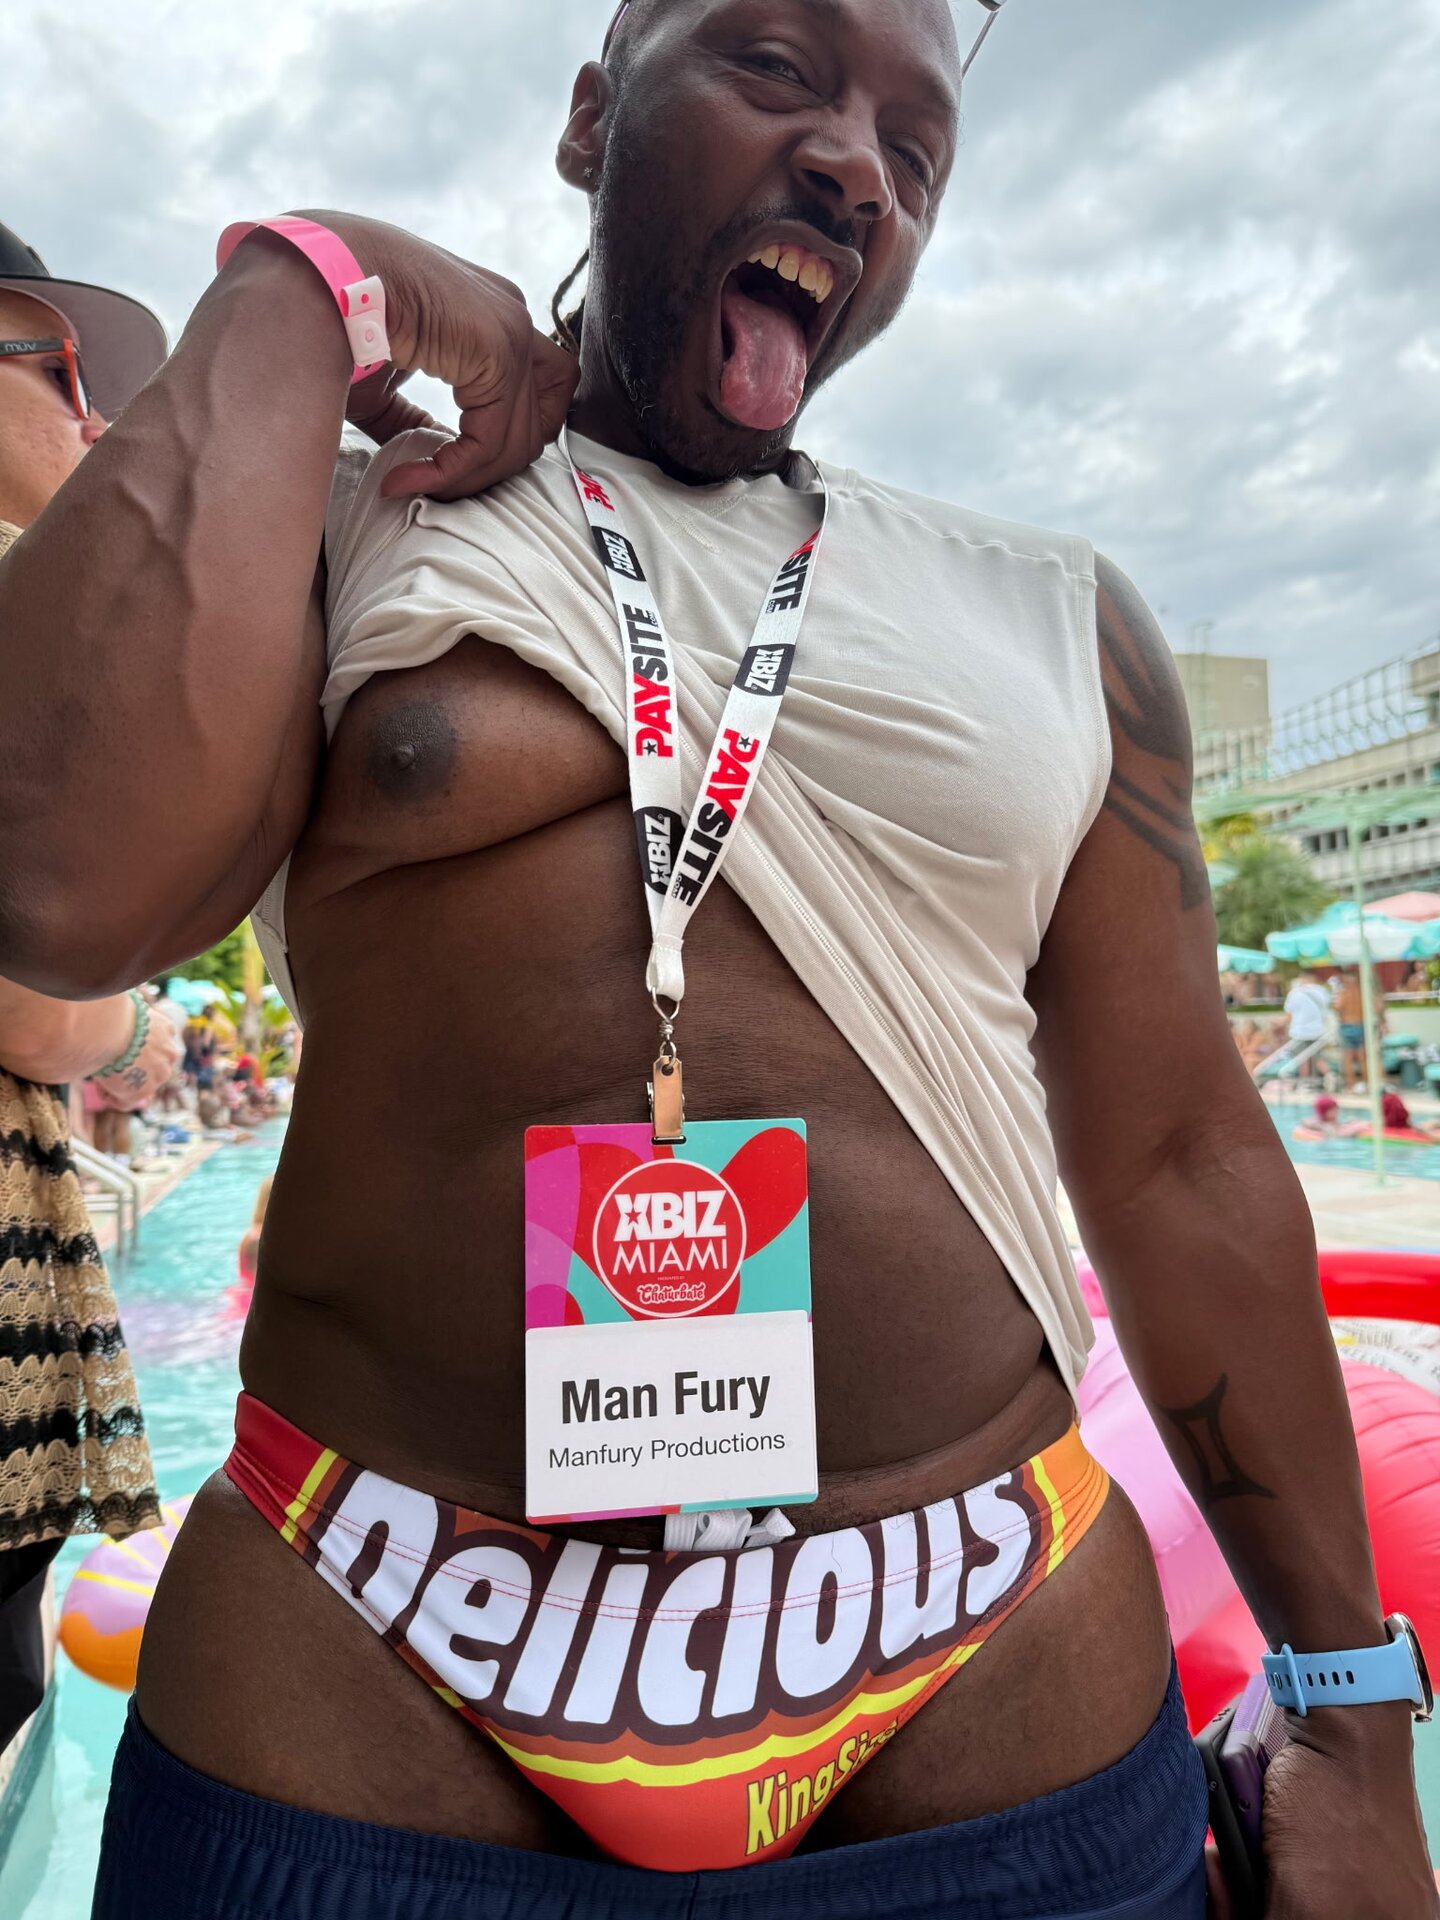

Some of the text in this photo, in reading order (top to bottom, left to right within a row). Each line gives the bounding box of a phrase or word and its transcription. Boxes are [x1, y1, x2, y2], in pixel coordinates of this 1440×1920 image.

[600, 530, 639, 578] XBIZ
[622, 602, 673, 758] PAYSITE
[744, 648, 785, 693] XBIZ
[679, 727, 761, 907] PAYSITE
[644, 813, 672, 887] XBIZ
[613, 1190, 727, 1242] XBIZ
[612, 1238, 728, 1275] MIAMI
[637, 1282, 706, 1304] Chaturbate
[561, 1371, 770, 1424] Man Fury
[549, 1433, 786, 1469] Manfury Productions
